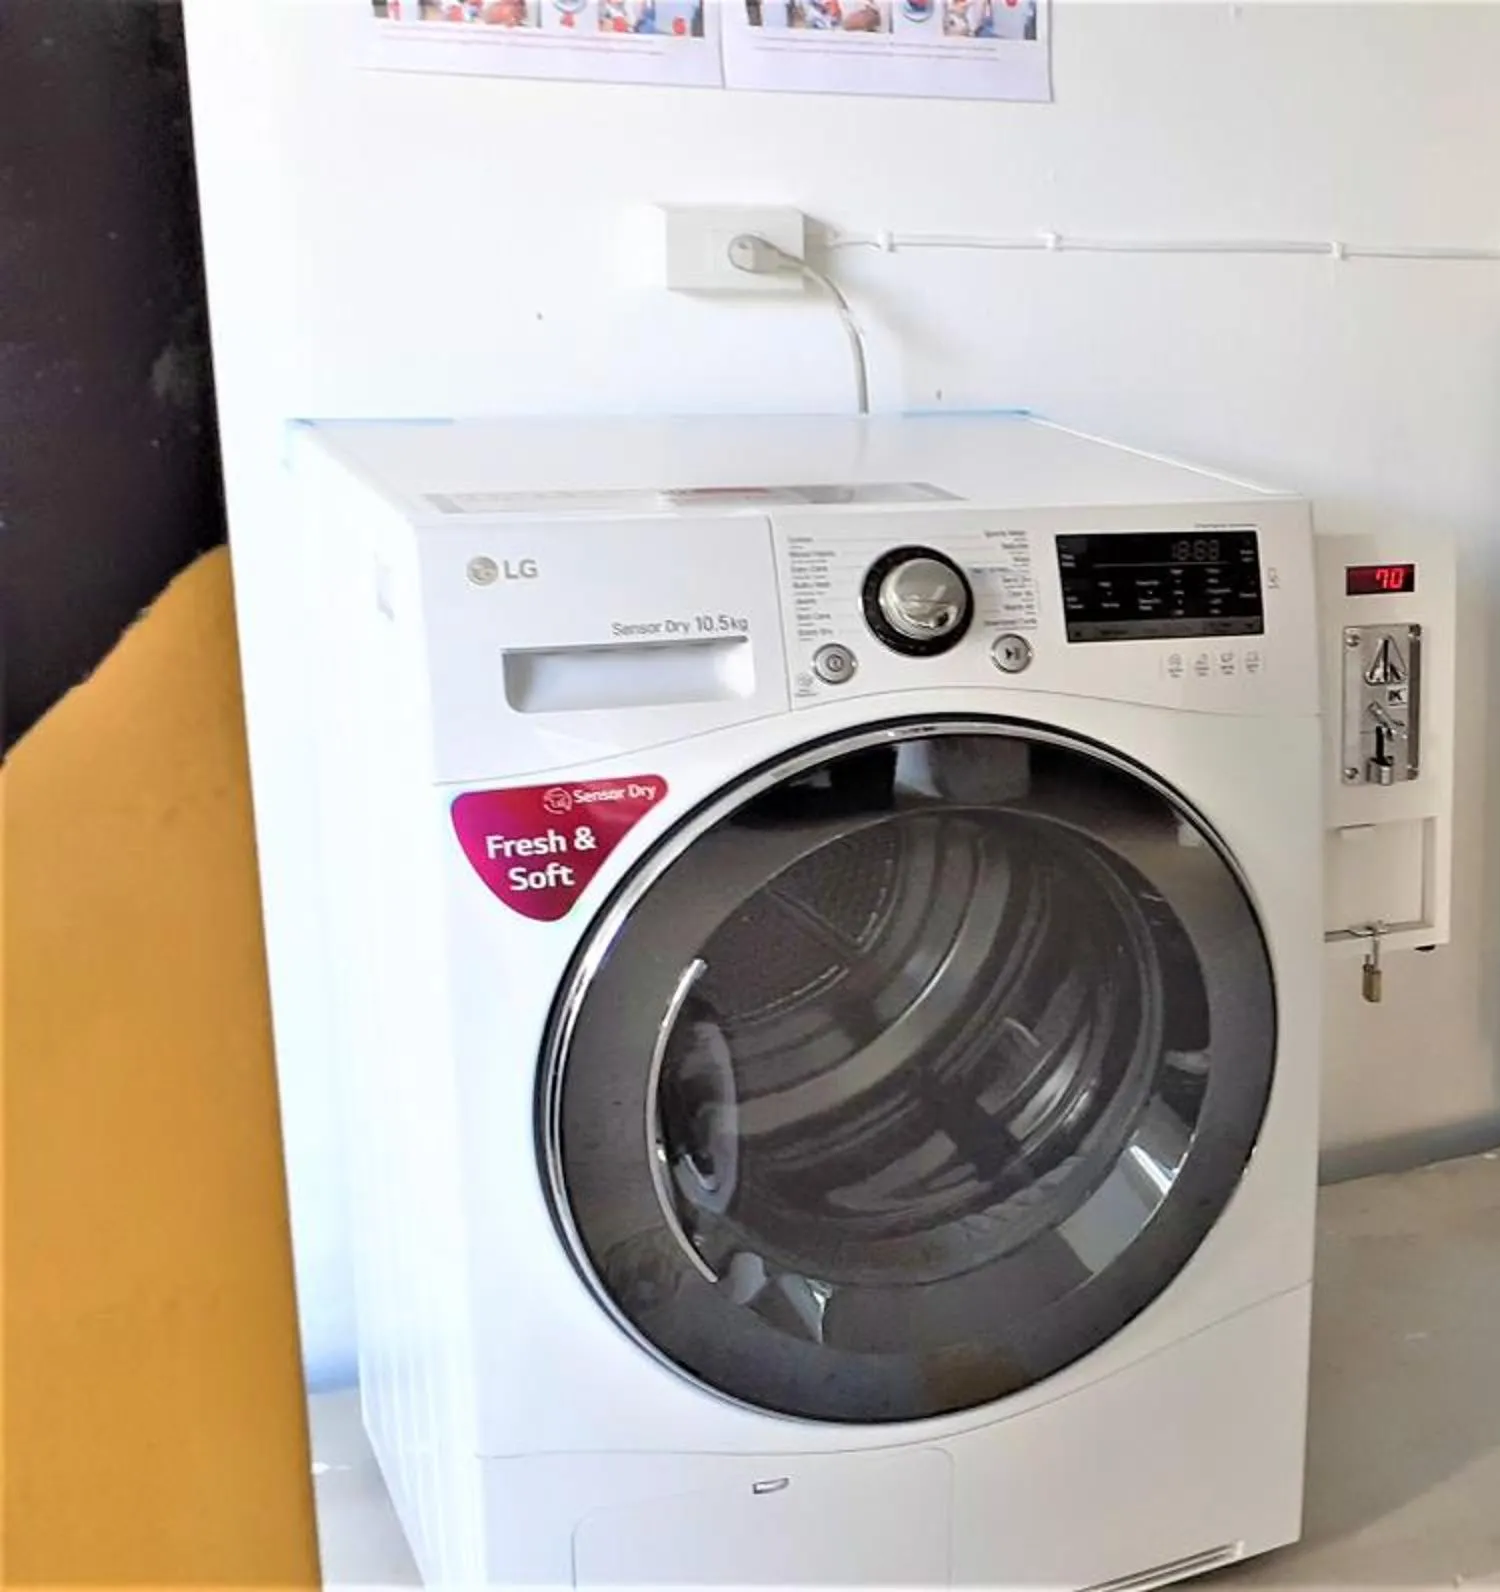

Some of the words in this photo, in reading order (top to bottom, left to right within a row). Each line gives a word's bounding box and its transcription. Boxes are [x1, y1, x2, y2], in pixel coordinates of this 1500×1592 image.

[503, 559, 538, 579] LG
[1375, 567, 1405, 589] 70
[611, 621, 662, 636] Sensor
[664, 618, 691, 636] Dry
[573, 789, 625, 804] Sensor
[628, 784, 657, 801] Dry
[485, 828, 567, 860] Fresh
[573, 825, 597, 852] &
[508, 862, 576, 892] Soft
